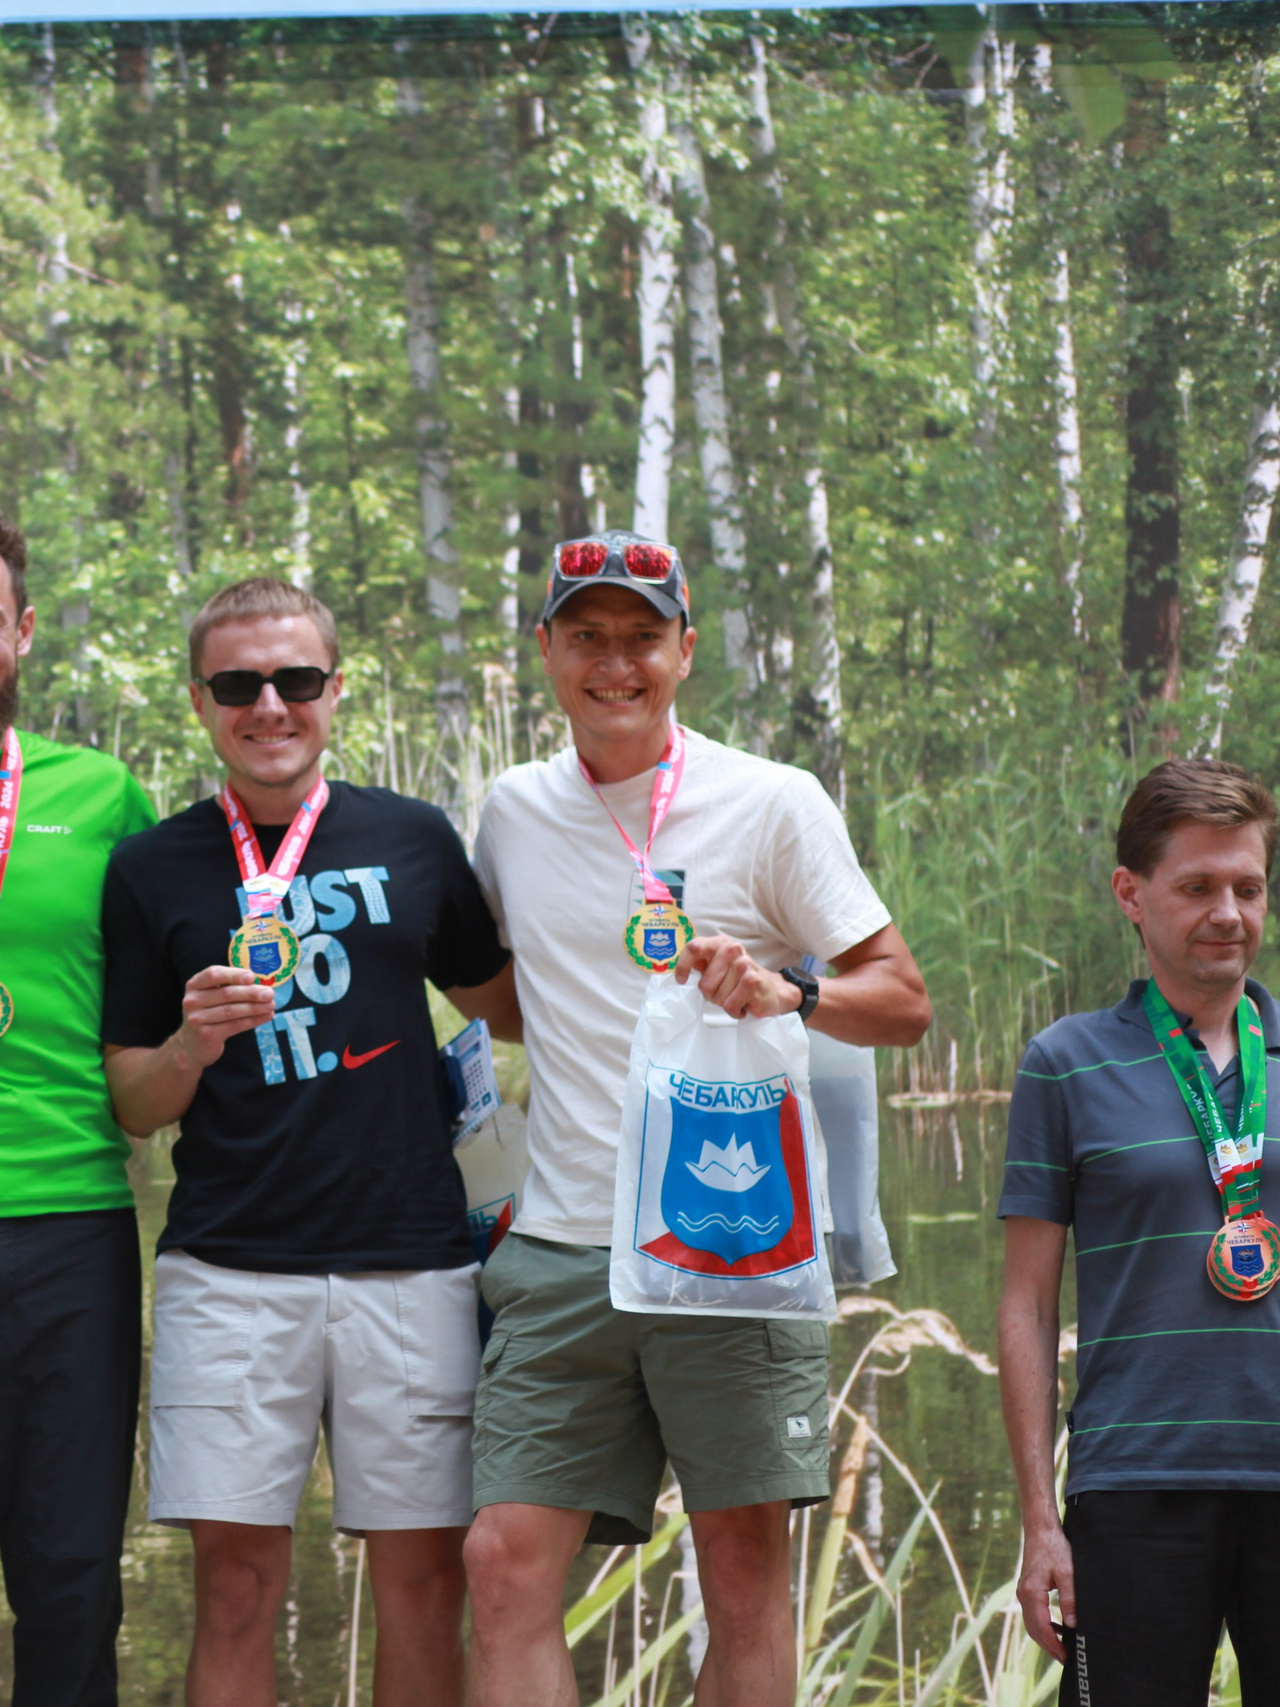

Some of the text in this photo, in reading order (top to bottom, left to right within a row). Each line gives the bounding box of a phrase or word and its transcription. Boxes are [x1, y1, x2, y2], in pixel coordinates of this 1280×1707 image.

[0, 781, 14, 810] 2024
[27, 824, 62, 835] CRAFT
[229, 866, 391, 940] UST
[254, 1006, 339, 1086] IT.
